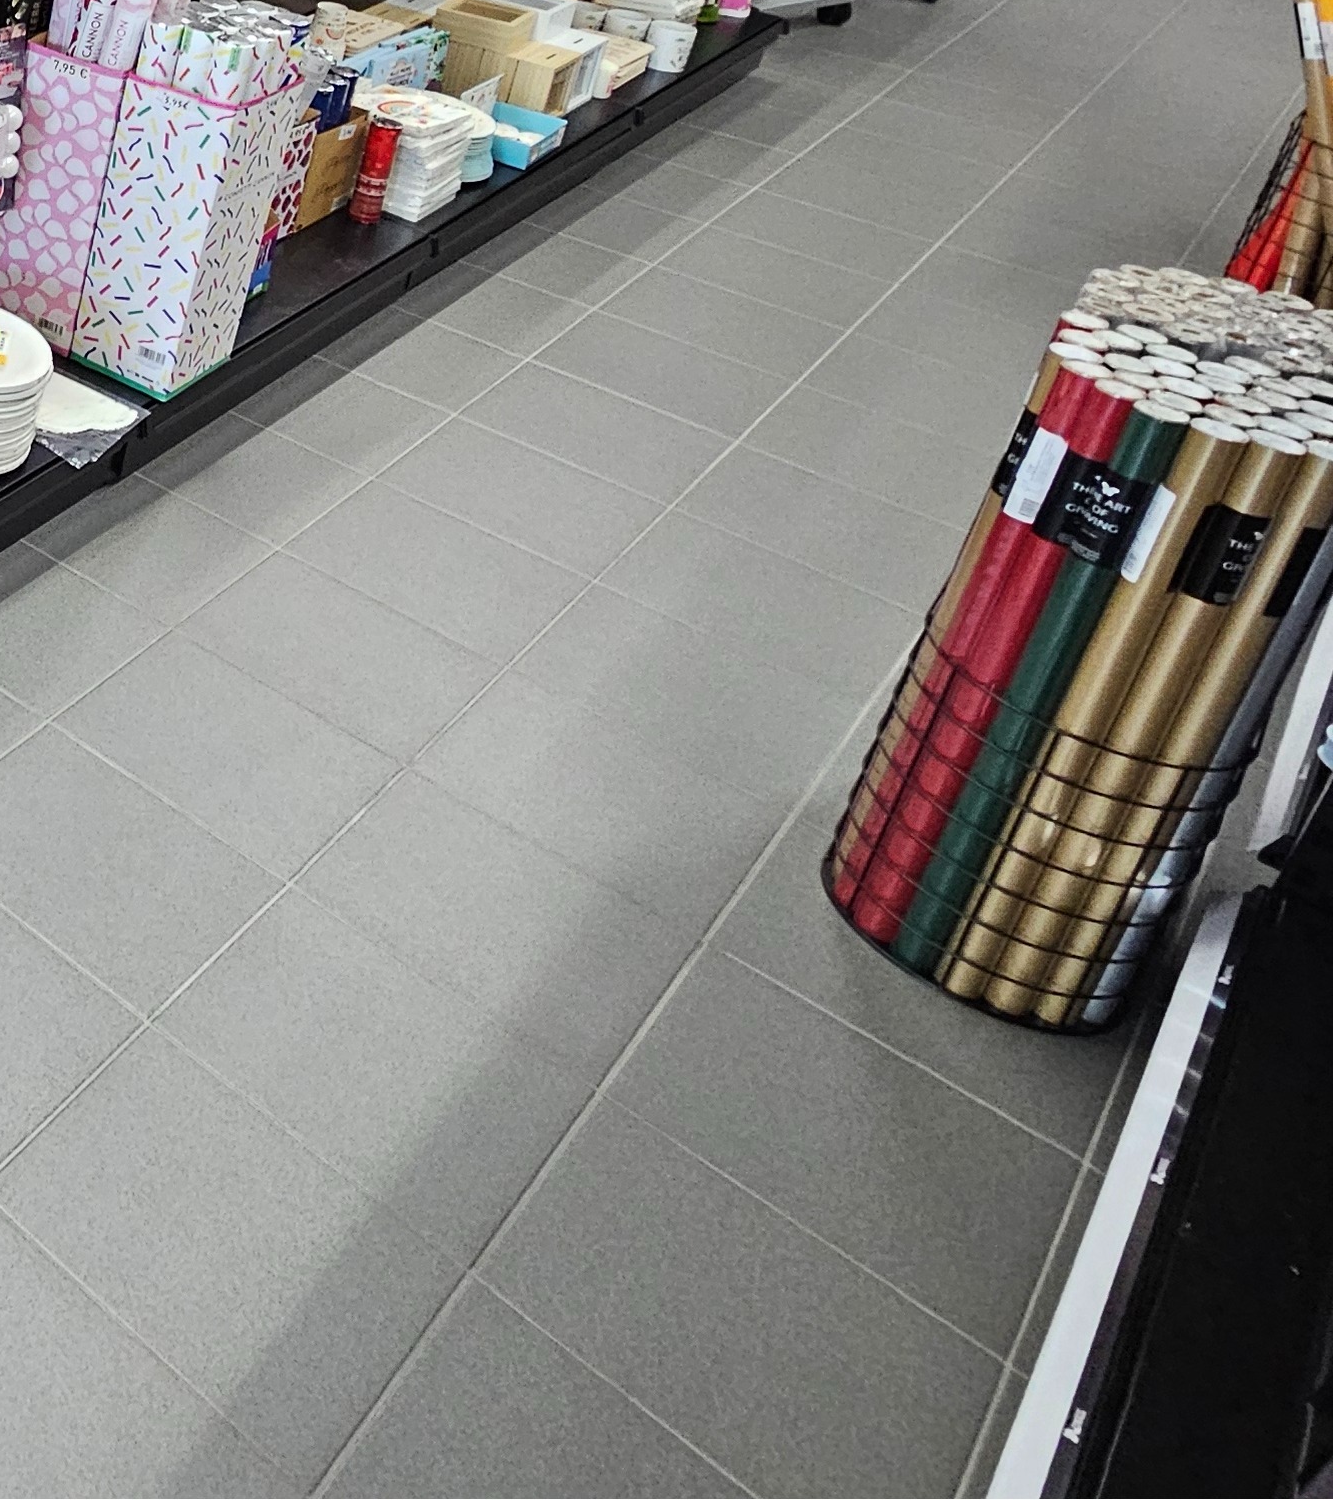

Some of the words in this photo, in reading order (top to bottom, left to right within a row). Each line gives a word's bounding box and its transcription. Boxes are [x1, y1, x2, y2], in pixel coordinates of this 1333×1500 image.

[81, 11, 106, 59] CANNON
[107, 19, 130, 67] CANNON
[53, 59, 76, 76] 7,95
